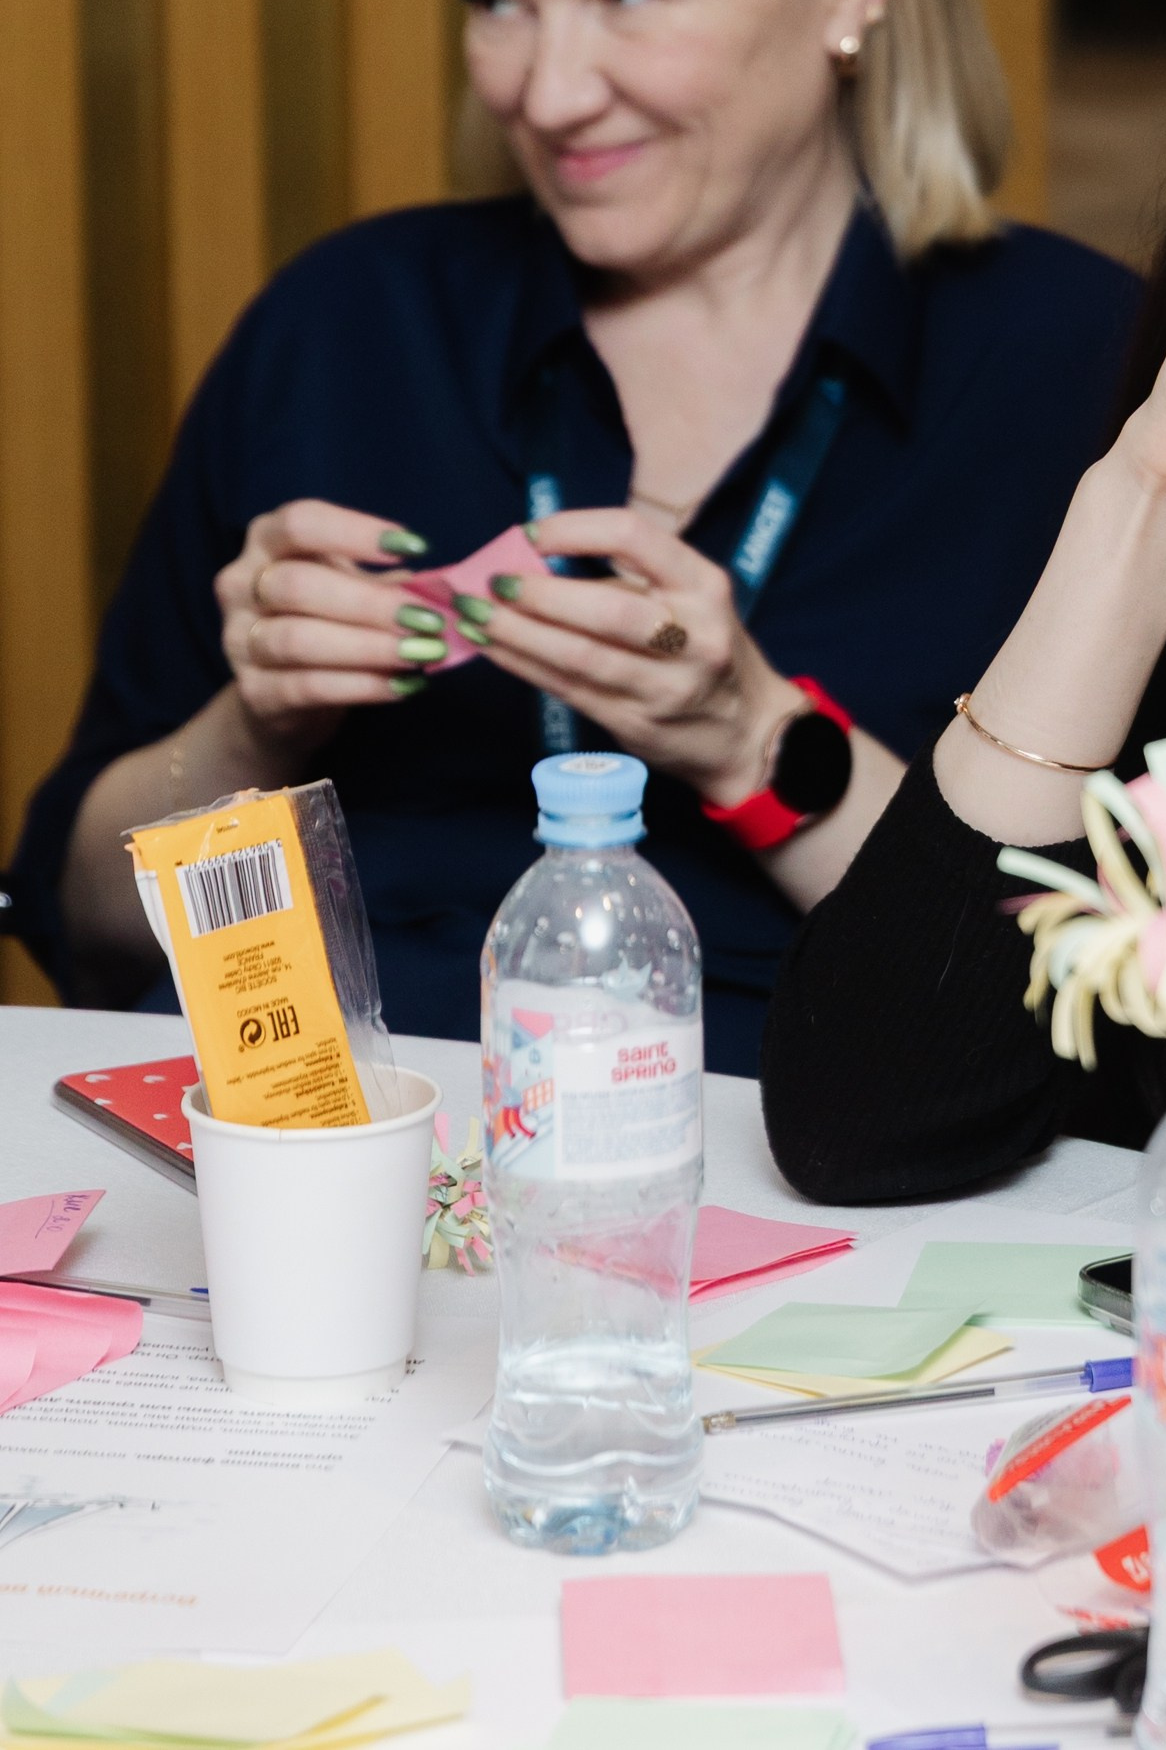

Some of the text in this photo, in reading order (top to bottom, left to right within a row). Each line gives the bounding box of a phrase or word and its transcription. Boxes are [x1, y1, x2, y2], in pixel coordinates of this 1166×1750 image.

[735, 488, 793, 575] LANCET
[236, 951, 264, 967] FRANCE
[242, 961, 262, 973] Clichy
[247, 968, 270, 981] Jeanne
[234, 983, 247, 994] BIC
[235, 995, 289, 1019] MADE IN MEXICO
